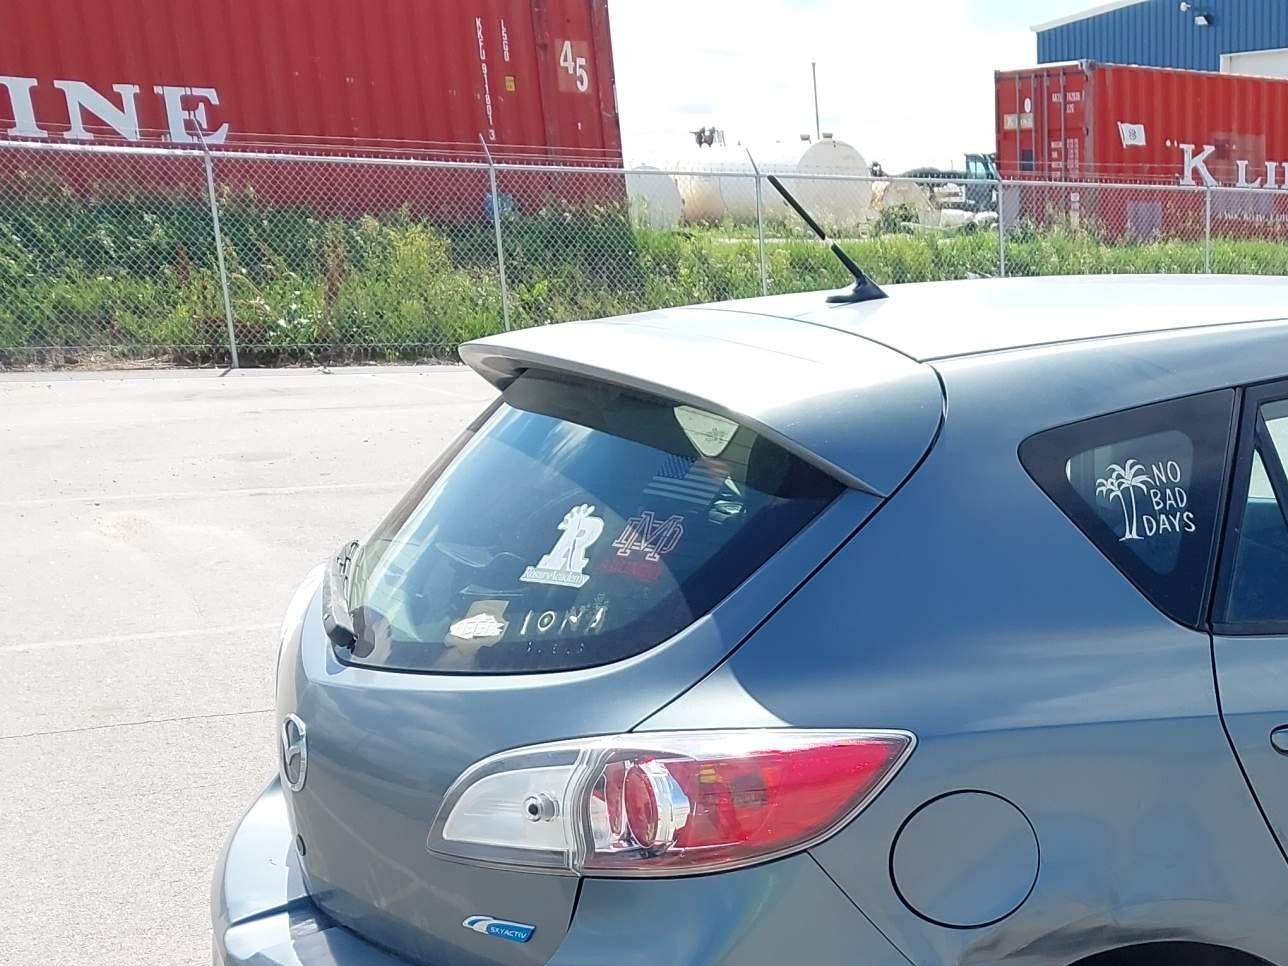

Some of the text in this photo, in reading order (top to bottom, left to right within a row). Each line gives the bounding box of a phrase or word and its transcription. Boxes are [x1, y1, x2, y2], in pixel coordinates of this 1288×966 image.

[559, 40, 589, 92] 45
[1151, 460, 1181, 485] NO
[1150, 487, 1187, 511] BAD
[1142, 512, 1196, 537] DAYS
[490, 926, 527, 938] SKYACTIV
